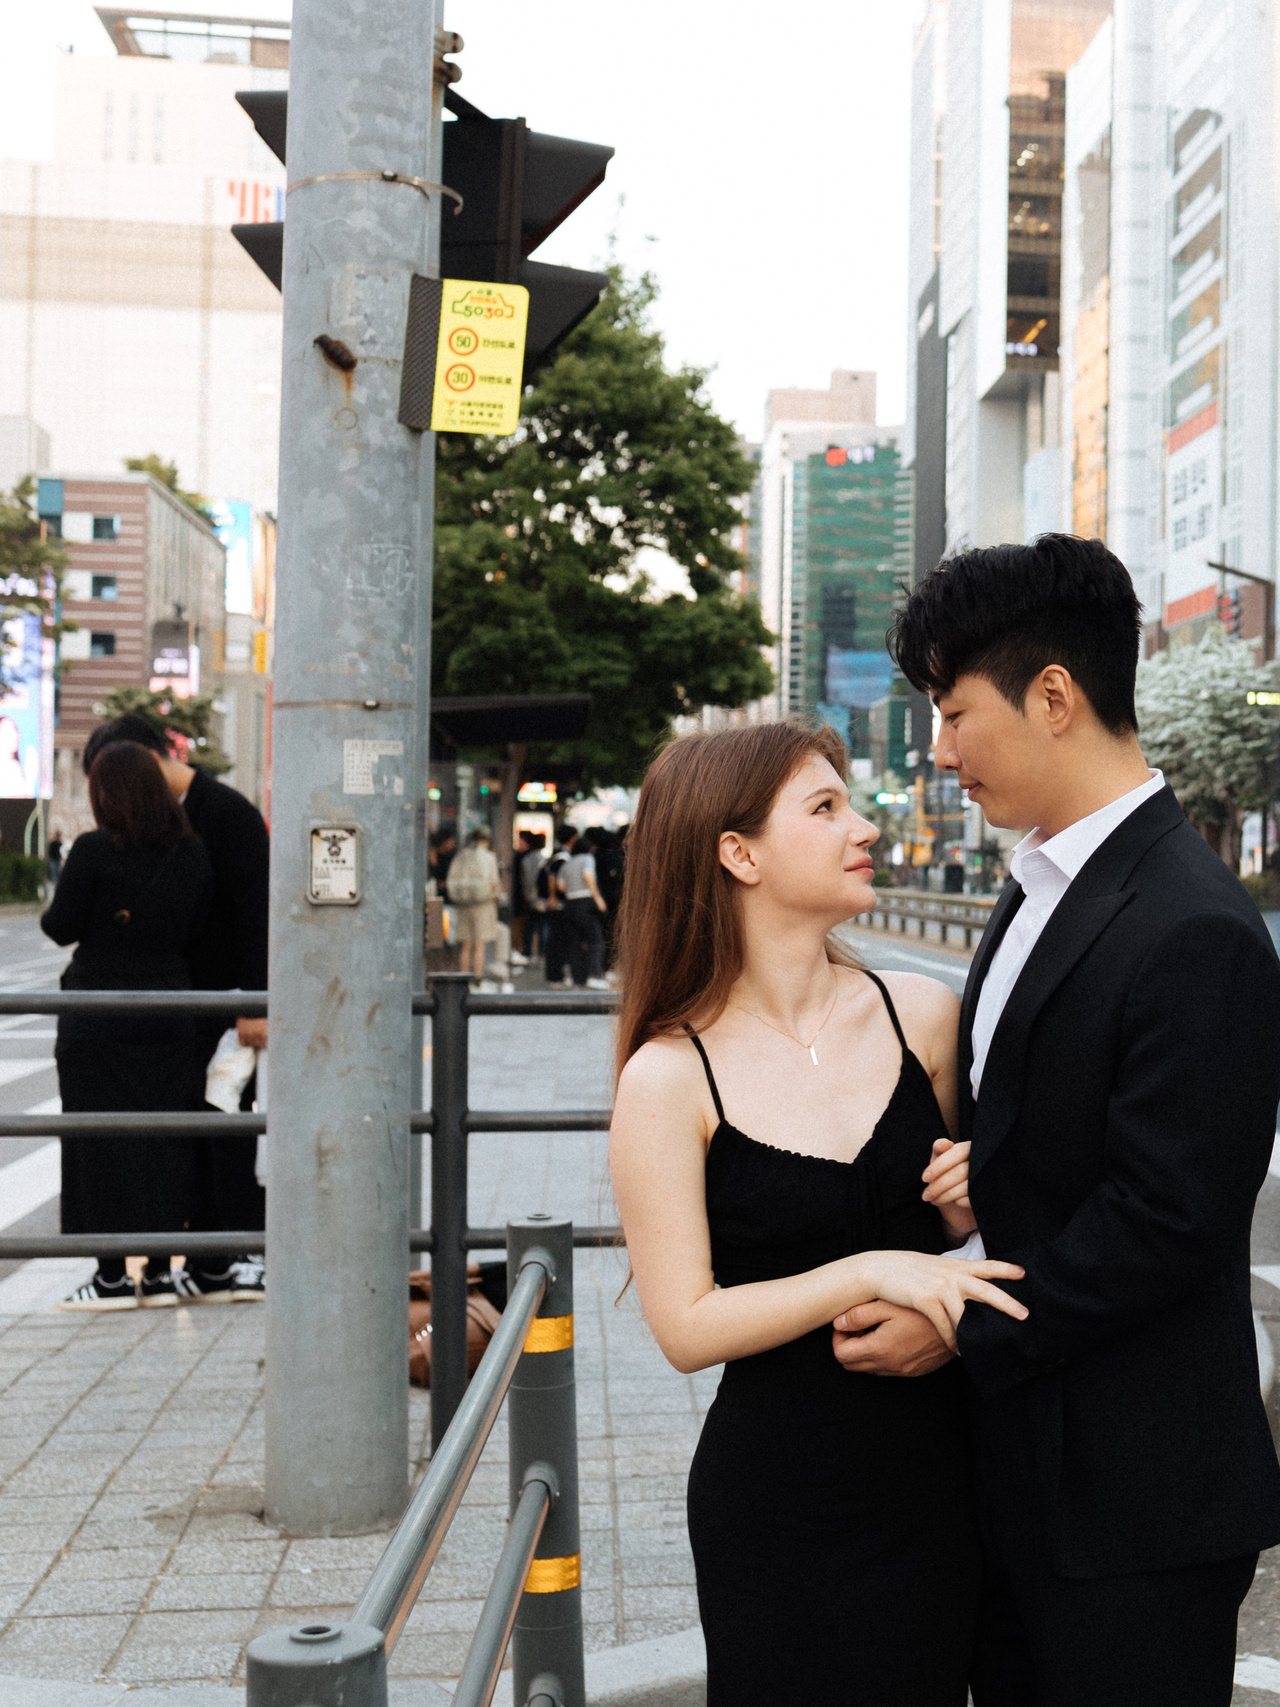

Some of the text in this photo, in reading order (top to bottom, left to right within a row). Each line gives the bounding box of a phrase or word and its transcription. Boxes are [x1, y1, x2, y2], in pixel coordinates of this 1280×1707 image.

[464, 305, 504, 319] 5030
[456, 335, 471, 348] 50
[452, 372, 468, 384] 30
